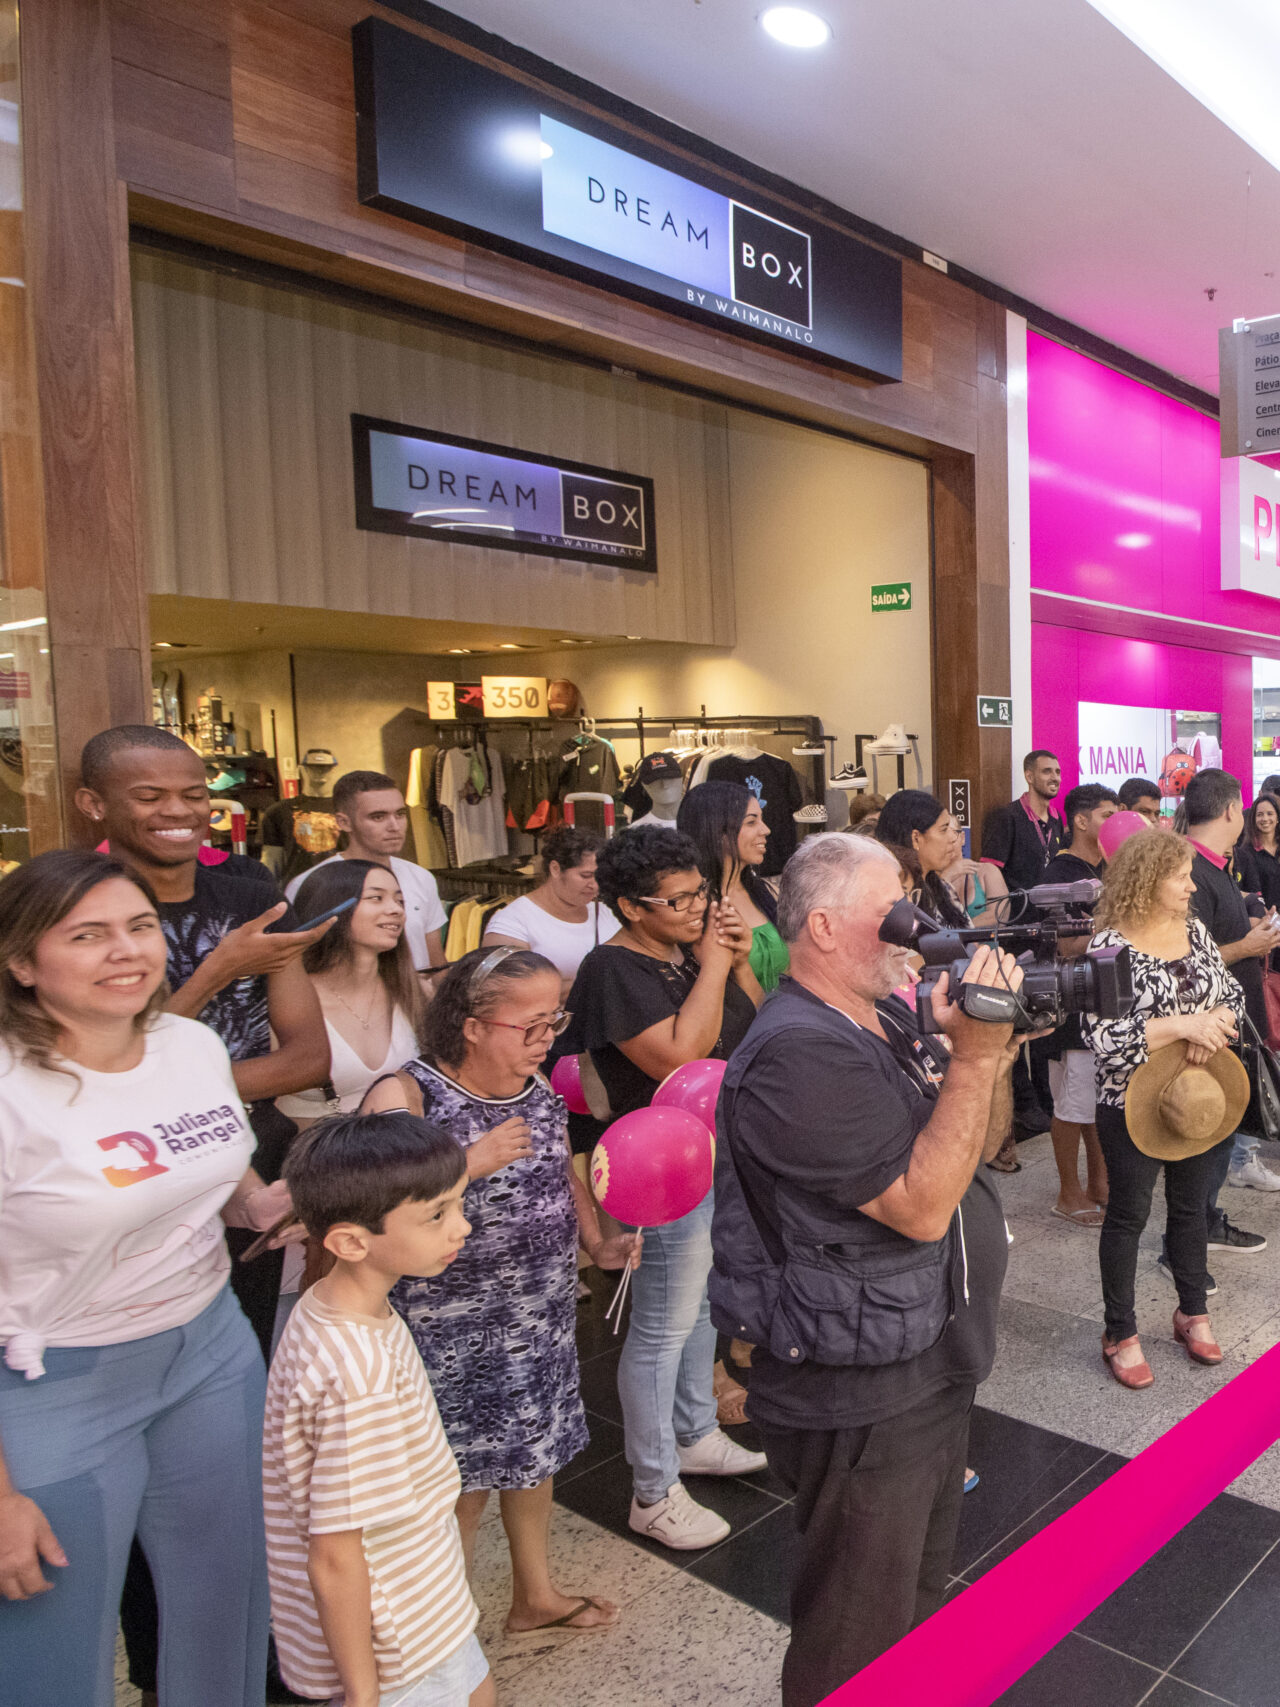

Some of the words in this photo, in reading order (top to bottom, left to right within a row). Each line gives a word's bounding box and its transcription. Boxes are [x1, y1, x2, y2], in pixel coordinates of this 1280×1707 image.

[588, 176, 709, 250] DREAM
[742, 242, 803, 289] BOX
[687, 289, 706, 306] BY
[715, 299, 813, 343] WAIMANALO
[1255, 330, 1280, 344] Praça
[1255, 352, 1279, 367] Pátio
[407, 463, 537, 511] DREAM
[573, 494, 639, 530] BOX
[541, 535, 557, 544] BY
[563, 538, 643, 558] WAIMANALO
[872, 591, 898, 606] SAÍDA
[491, 686, 540, 709] 350
[1089, 746, 1147, 775] MANIA
[153, 1104, 235, 1140] Juliana
[165, 1115, 245, 1155] Rangel
